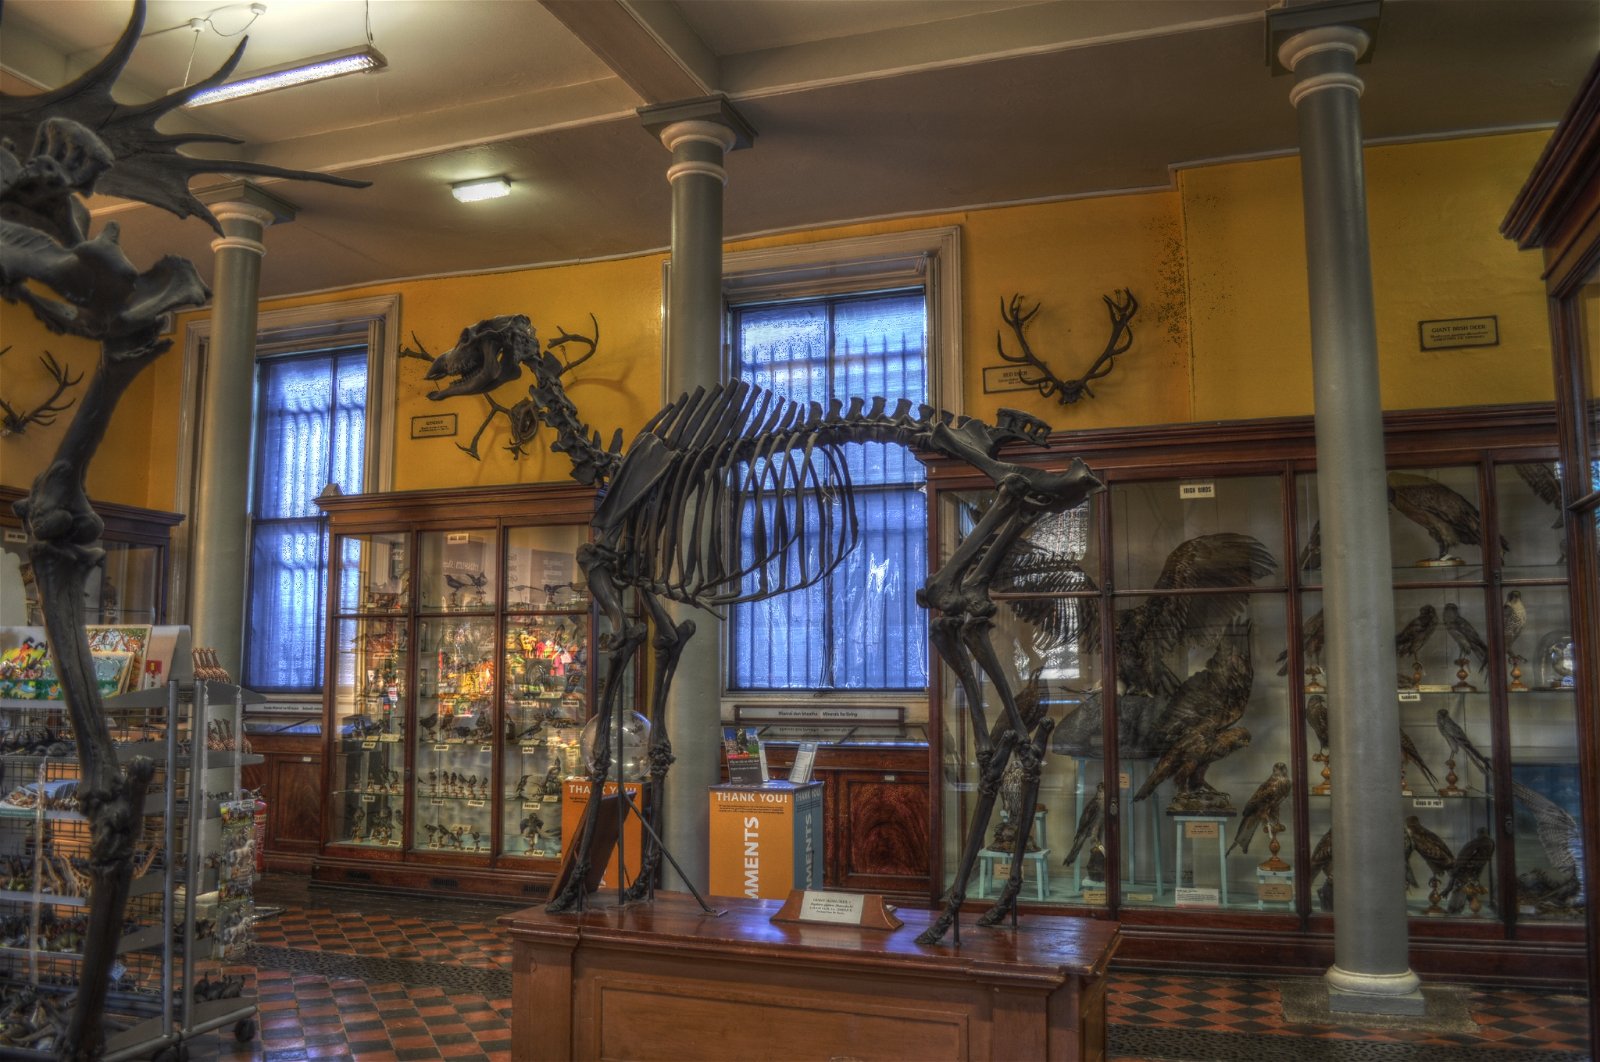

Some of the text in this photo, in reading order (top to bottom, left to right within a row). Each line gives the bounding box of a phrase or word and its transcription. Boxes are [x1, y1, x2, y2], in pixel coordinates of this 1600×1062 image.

[568, 779, 607, 796] THAK
[716, 792, 788, 804] THANK YOU!
